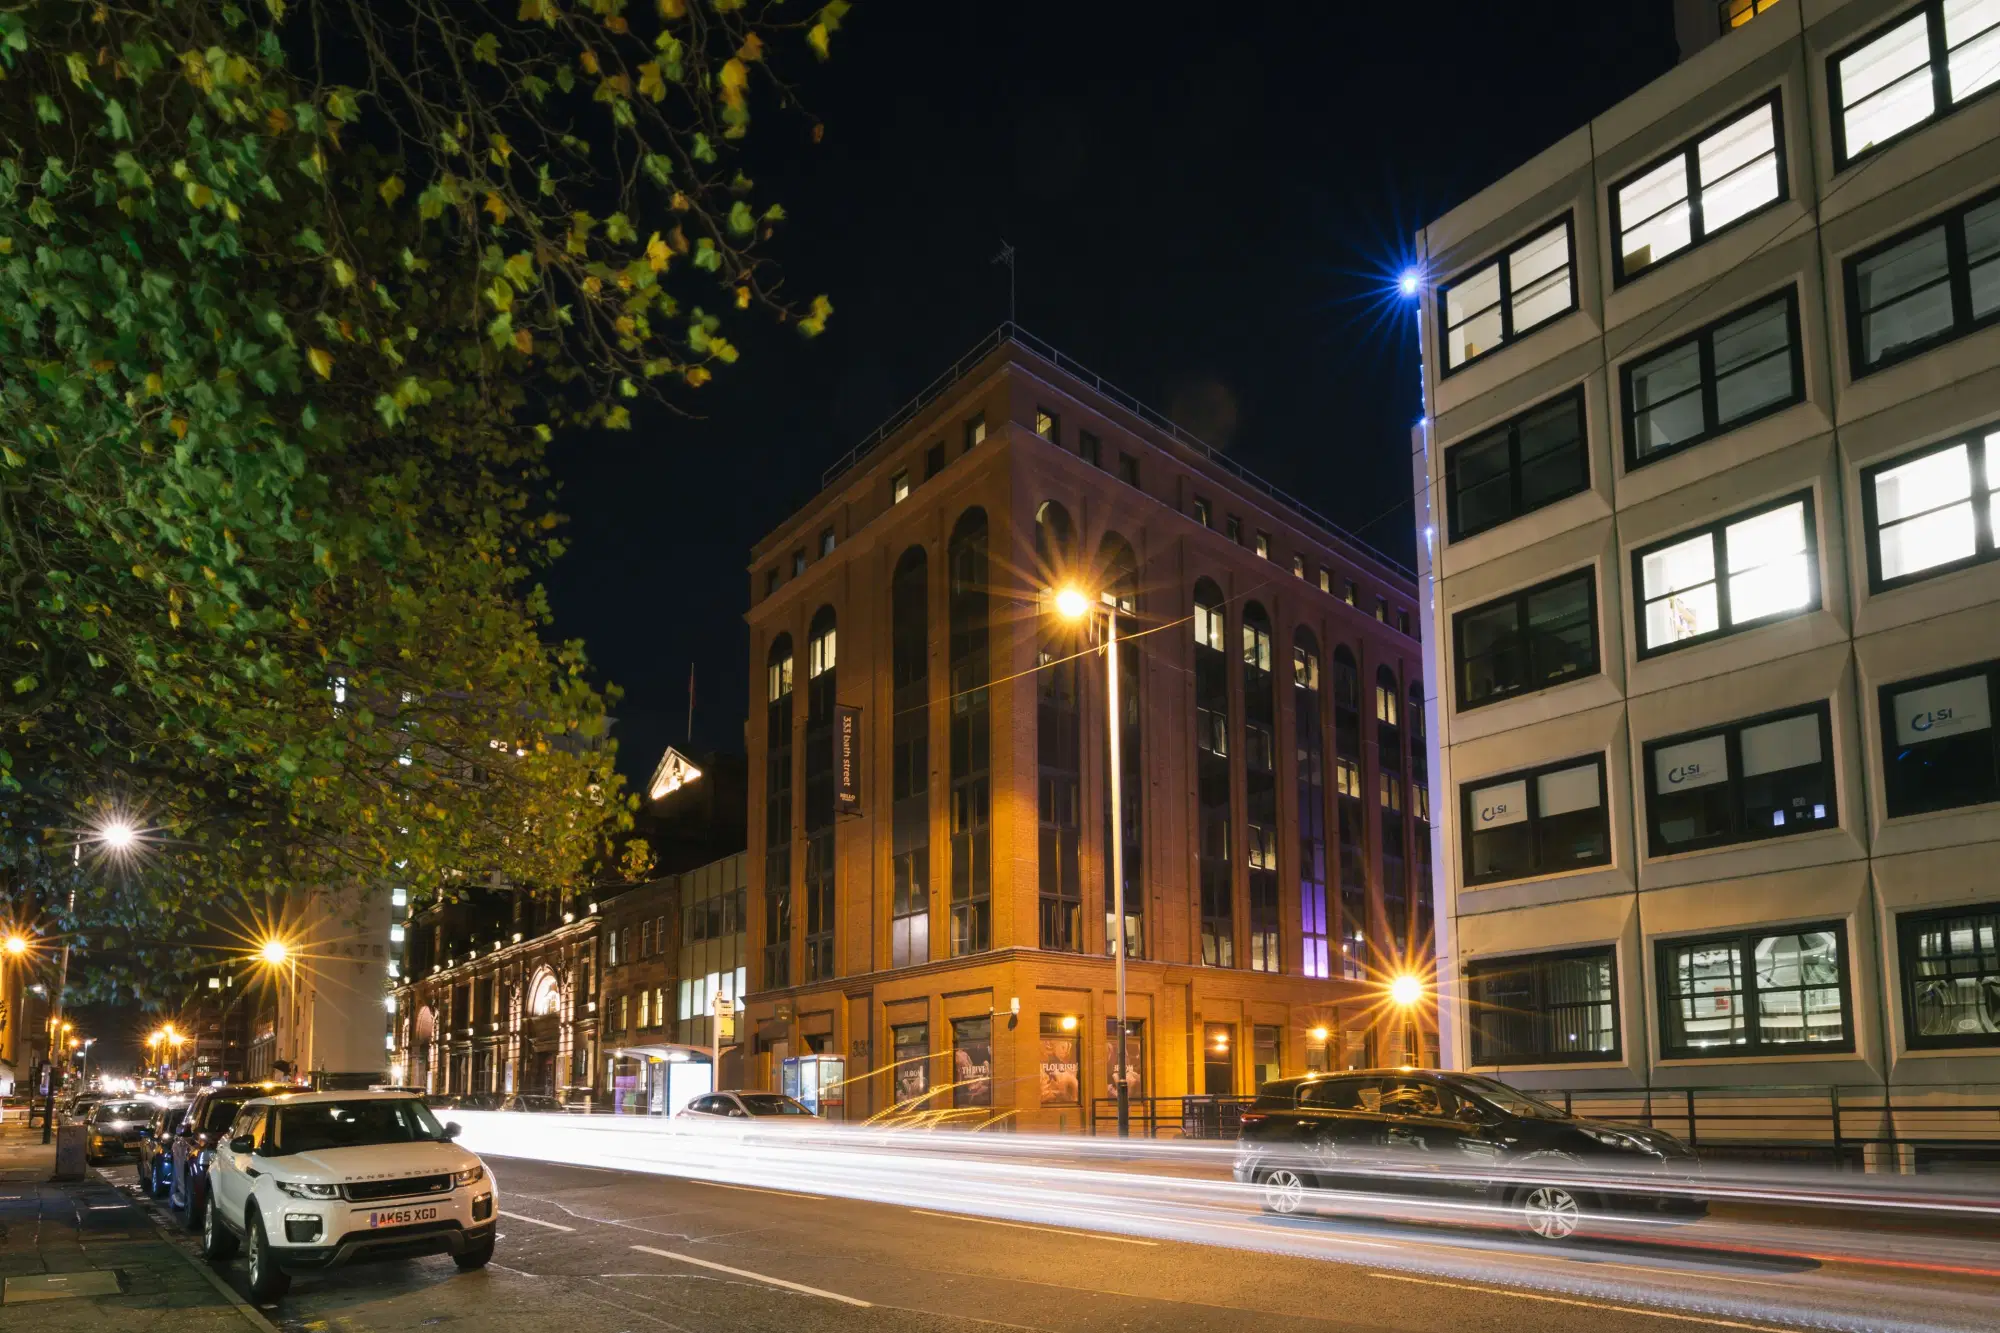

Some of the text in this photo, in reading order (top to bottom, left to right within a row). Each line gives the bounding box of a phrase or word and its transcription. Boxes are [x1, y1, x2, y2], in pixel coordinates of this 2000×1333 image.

[843, 735, 851, 757] bath
[843, 759, 851, 786] street
[961, 1065, 986, 1075] THRIVE
[1042, 1063, 1076, 1072] FLOURISH
[379, 1208, 437, 1224] AK65 XGD
